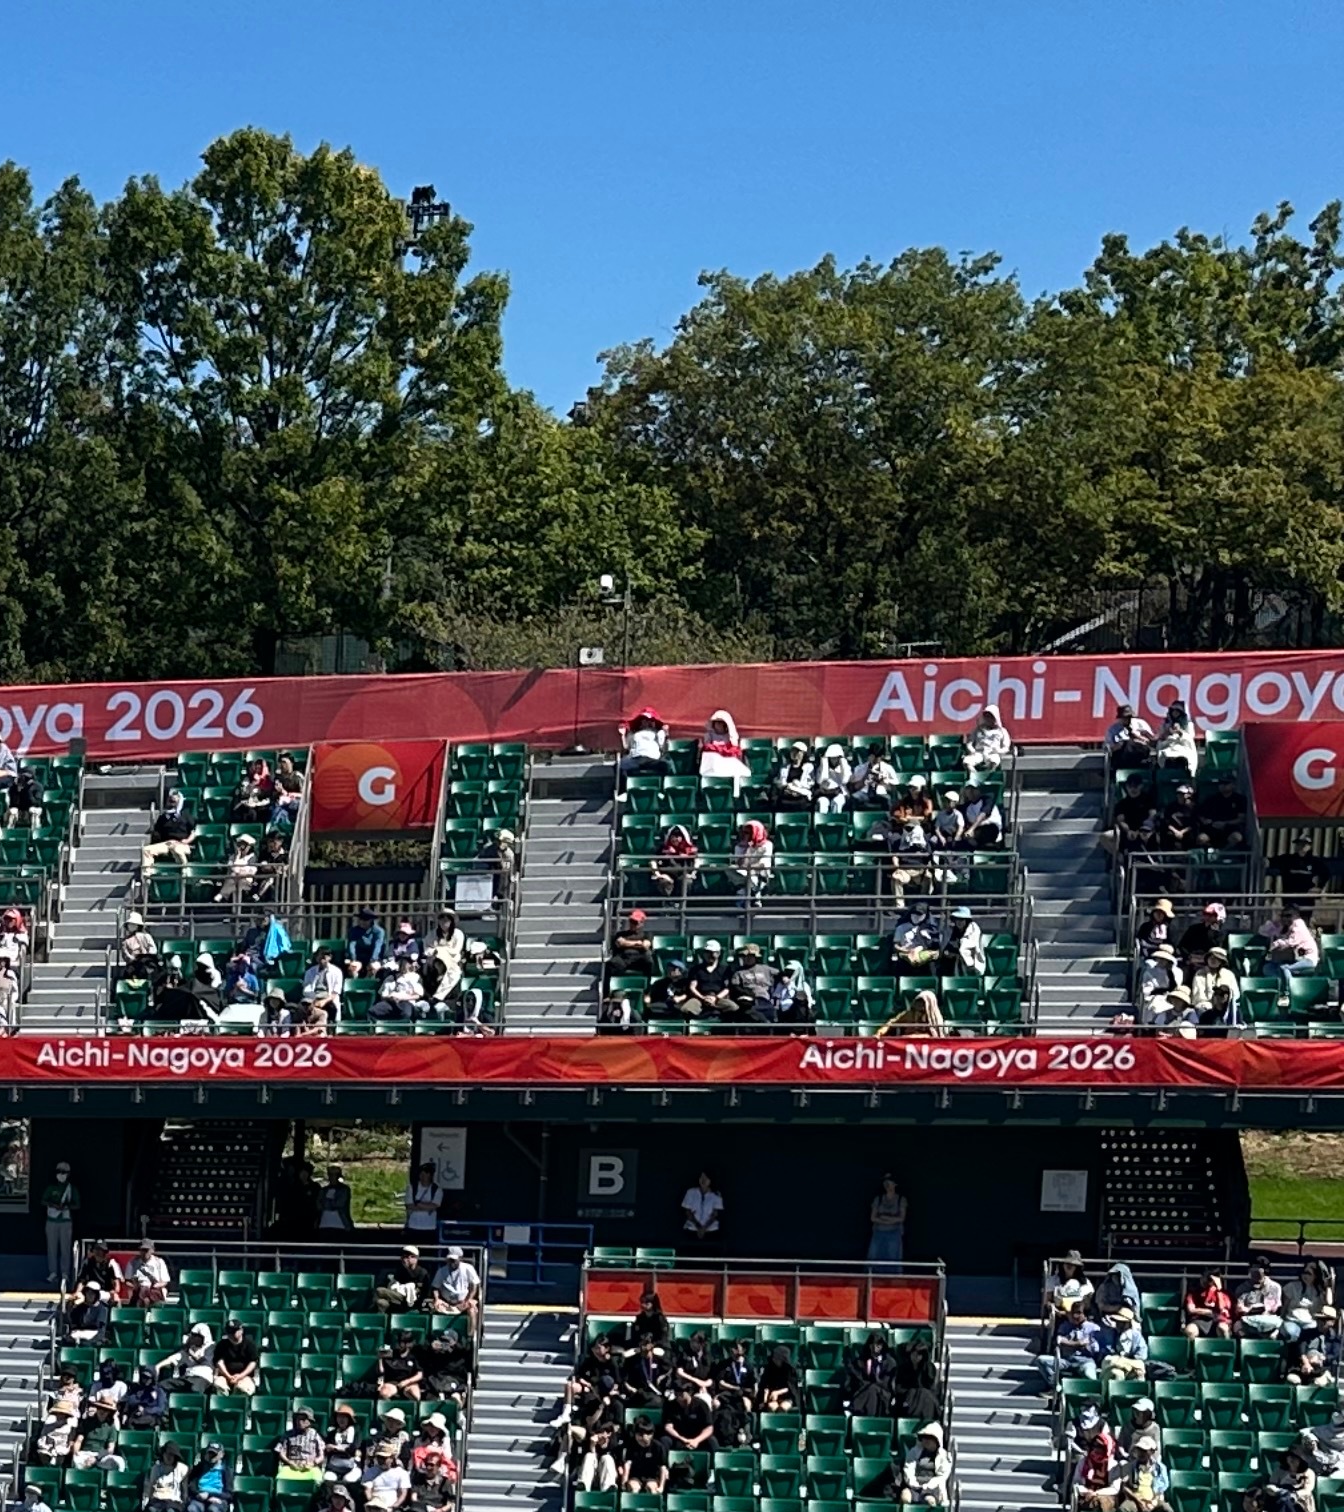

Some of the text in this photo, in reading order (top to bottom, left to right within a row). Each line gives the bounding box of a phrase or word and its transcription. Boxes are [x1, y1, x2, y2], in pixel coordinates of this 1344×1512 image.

[105, 688, 264, 740] 2026
[867, 661, 1344, 731] Aichi-Nagoy
[358, 766, 396, 806] G
[1293, 748, 1337, 790] G
[36, 1040, 333, 1074] Aichi-Nagoya 2026
[799, 1040, 1136, 1078] Aichi-Nagoya 2026
[588, 1155, 625, 1196] B
